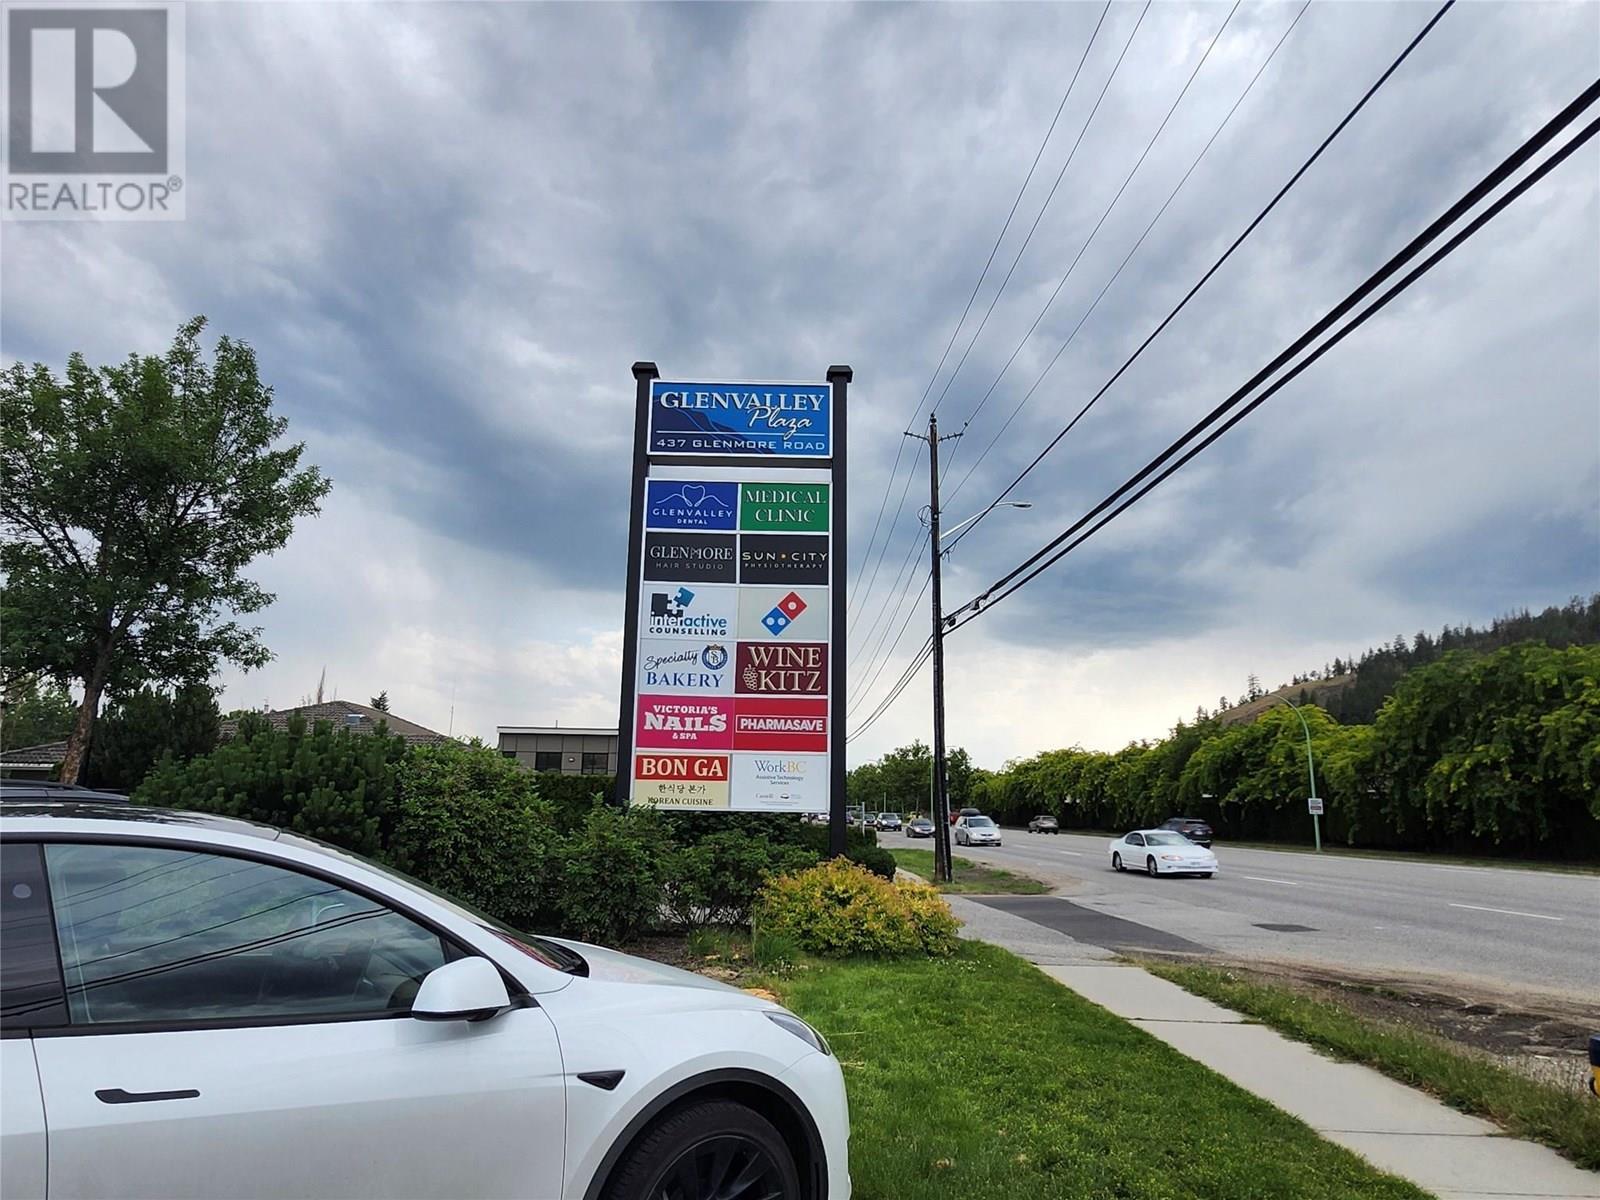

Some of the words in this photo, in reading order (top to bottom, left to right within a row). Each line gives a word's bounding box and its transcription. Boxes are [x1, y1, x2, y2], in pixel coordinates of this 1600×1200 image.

[660, 391, 825, 411] GLENVALLEY
[747, 406, 813, 440] Plaza
[656, 438, 686, 448] 437
[692, 439, 777, 449] GLENMORE
[783, 441, 825, 450] ROAD
[745, 490, 827, 504] MEDICAL
[652, 508, 733, 518] GLENVALLEY
[755, 508, 816, 523] CLINIC
[650, 545, 733, 560] GLENMORE
[742, 552, 776, 561] SUN
[791, 552, 828, 561] CITY
[655, 561, 680, 569] HAIR
[685, 562, 724, 570] STUDIO
[650, 611, 727, 628] interactive
[649, 627, 727, 636] COUNSELLING
[643, 649, 700, 671] Specialty
[747, 646, 822, 668] WINE
[647, 671, 724, 688] BAKERY
[758, 669, 822, 692] KITZ
[653, 704, 718, 715] VICTORIA'S
[643, 711, 727, 733] NAILS
[740, 718, 823, 731] PHARMASAVE
[672, 732, 679, 740] &
[680, 732, 698, 740] SPA
[641, 758, 688, 777] BON
[694, 759, 723, 777] GA
[754, 760, 807, 773] WorkBC
[682, 797, 713, 805] CUISINE
